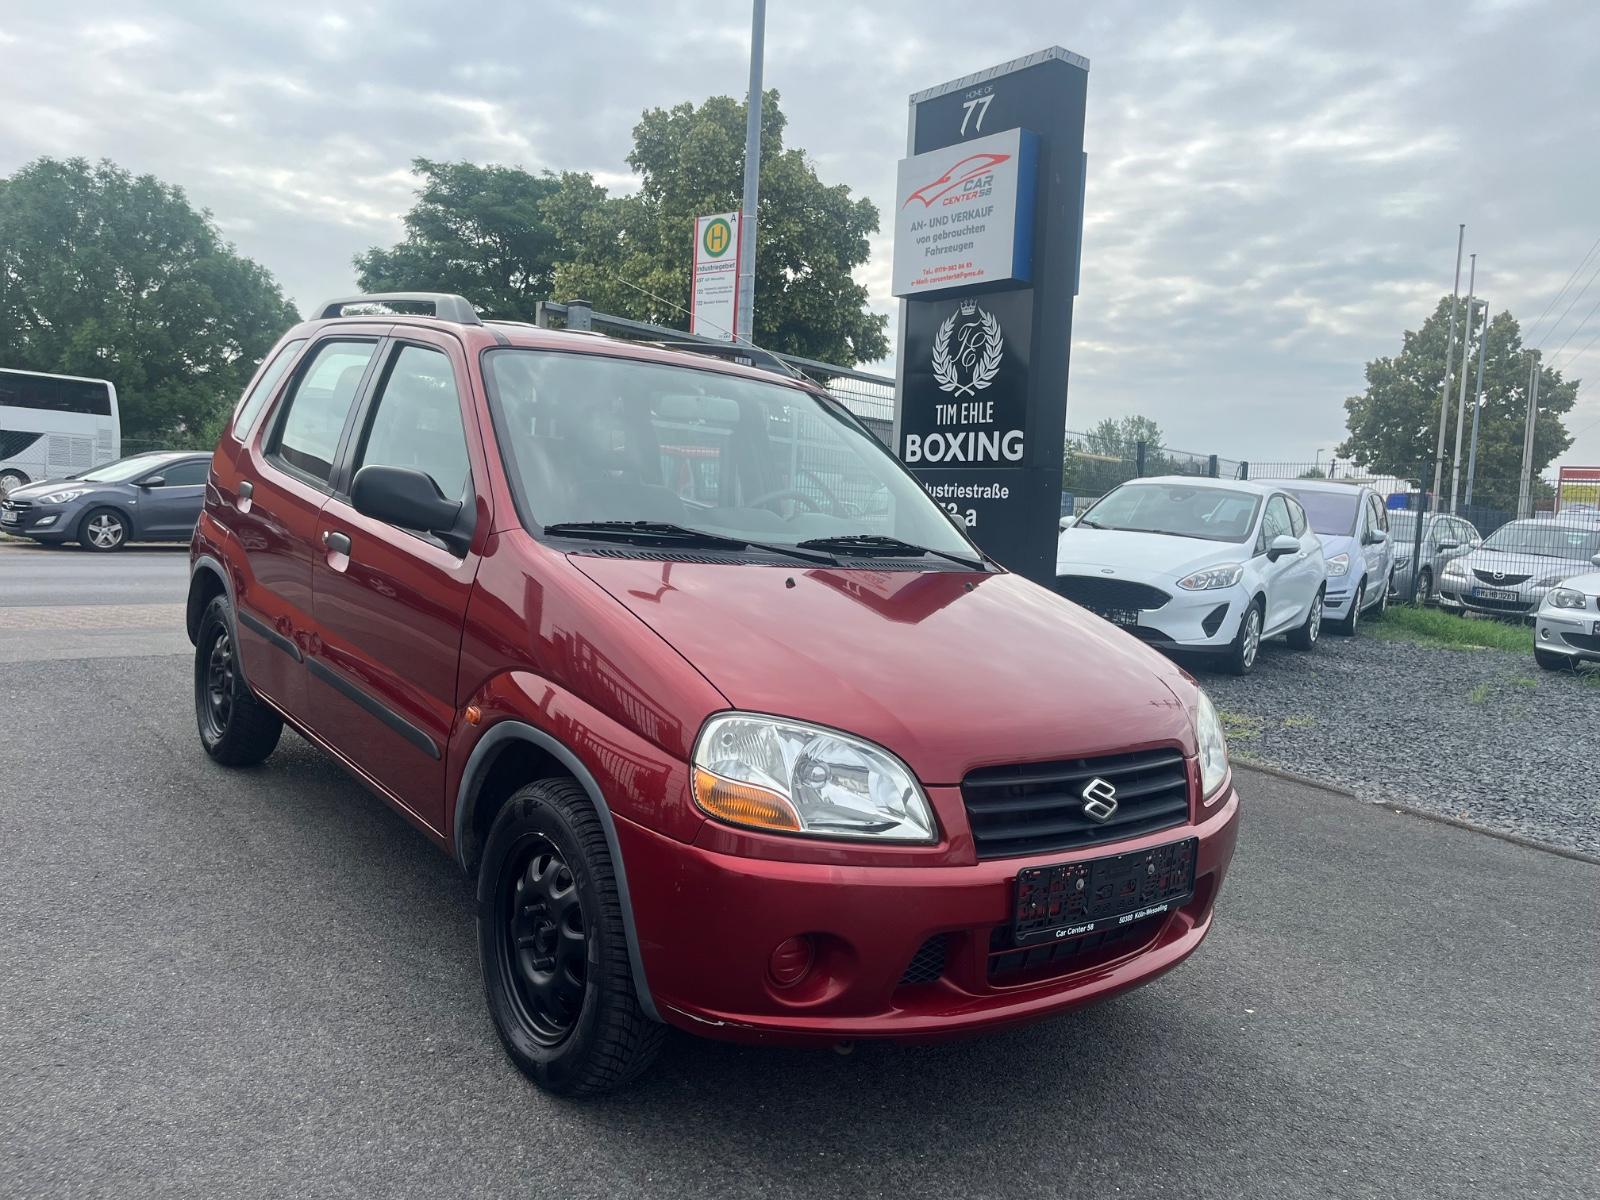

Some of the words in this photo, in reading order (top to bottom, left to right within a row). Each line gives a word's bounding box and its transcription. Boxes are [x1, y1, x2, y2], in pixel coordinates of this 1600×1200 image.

[966, 88, 983, 99] HOME
[984, 84, 994, 94] OF
[960, 93, 995, 136] 77
[963, 175, 994, 192] CAR
[730, 213, 737, 223] A
[910, 220, 927, 232] AN-
[929, 215, 949, 228] UND
[951, 205, 994, 223] VERKAUF
[916, 235, 931, 245] von
[932, 224, 986, 243] gebrauchten
[925, 241, 974, 257] Fahrzeugen
[935, 403, 957, 425] TIM
[961, 401, 994, 424] EHLE
[905, 430, 1024, 463] BOXING
[965, 508, 977, 527] a
[1055, 930, 1067, 938] Car
[1067, 926, 1087, 935] Center
[1087, 923, 1095, 931] 58
